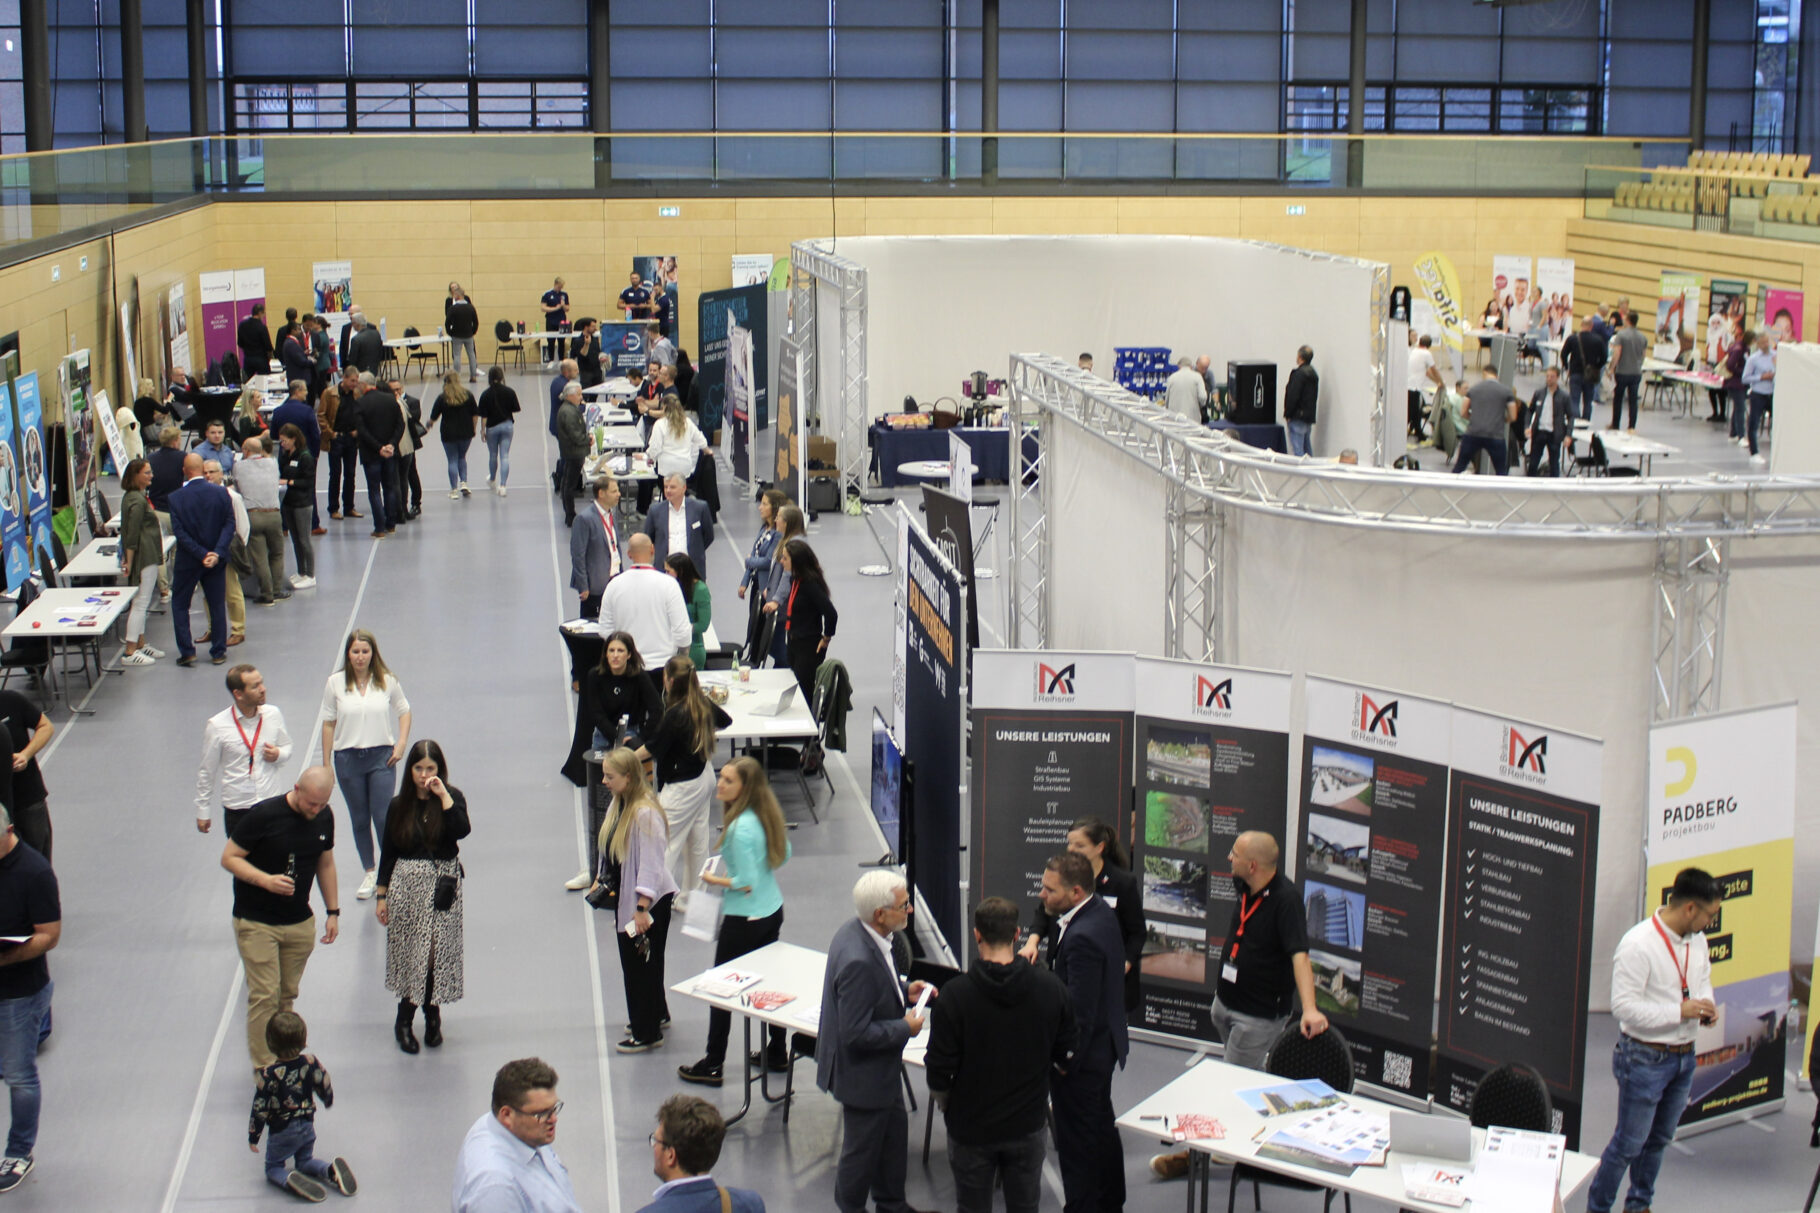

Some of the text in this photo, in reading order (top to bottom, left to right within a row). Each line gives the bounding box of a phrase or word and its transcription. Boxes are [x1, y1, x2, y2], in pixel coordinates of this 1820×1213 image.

[940, 578, 951, 628] FÜR
[920, 591, 953, 668] UNTERNEHMEN
[1038, 695, 1076, 703] Reihsner
[996, 731, 1111, 743] UNSERE LEISTUNGEN
[1359, 732, 1398, 748] Reihsner
[1035, 766, 1070, 774] Straßenbau
[1507, 769, 1547, 784] Reihsner
[1033, 775, 1071, 784] GIS Systeme
[1033, 785, 1071, 793] Industriebau
[1470, 797, 1576, 837] UNSERE LEISTUNGEN
[1663, 797, 1737, 825] PADBERG
[1023, 827, 1069, 836] Wasserversorg
[1468, 820, 1492, 835] STATIK
[1663, 822, 1716, 840] projektbau
[1481, 867, 1512, 883] STAHLBAU
[1502, 859, 1517, 869] UND
[1518, 862, 1543, 876] TIEFBAU
[1480, 899, 1531, 921] STAHLBETONBAU
[1479, 915, 1521, 934] INDUSTRIEBAU
[1490, 953, 1519, 969] HOLZBAU
[1477, 965, 1519, 985] FASSADENBAU
[1475, 995, 1516, 1015] ANLAGENBAU
[1474, 1010, 1494, 1025] BAUEN
[1502, 1018, 1531, 1036] BESTAND
